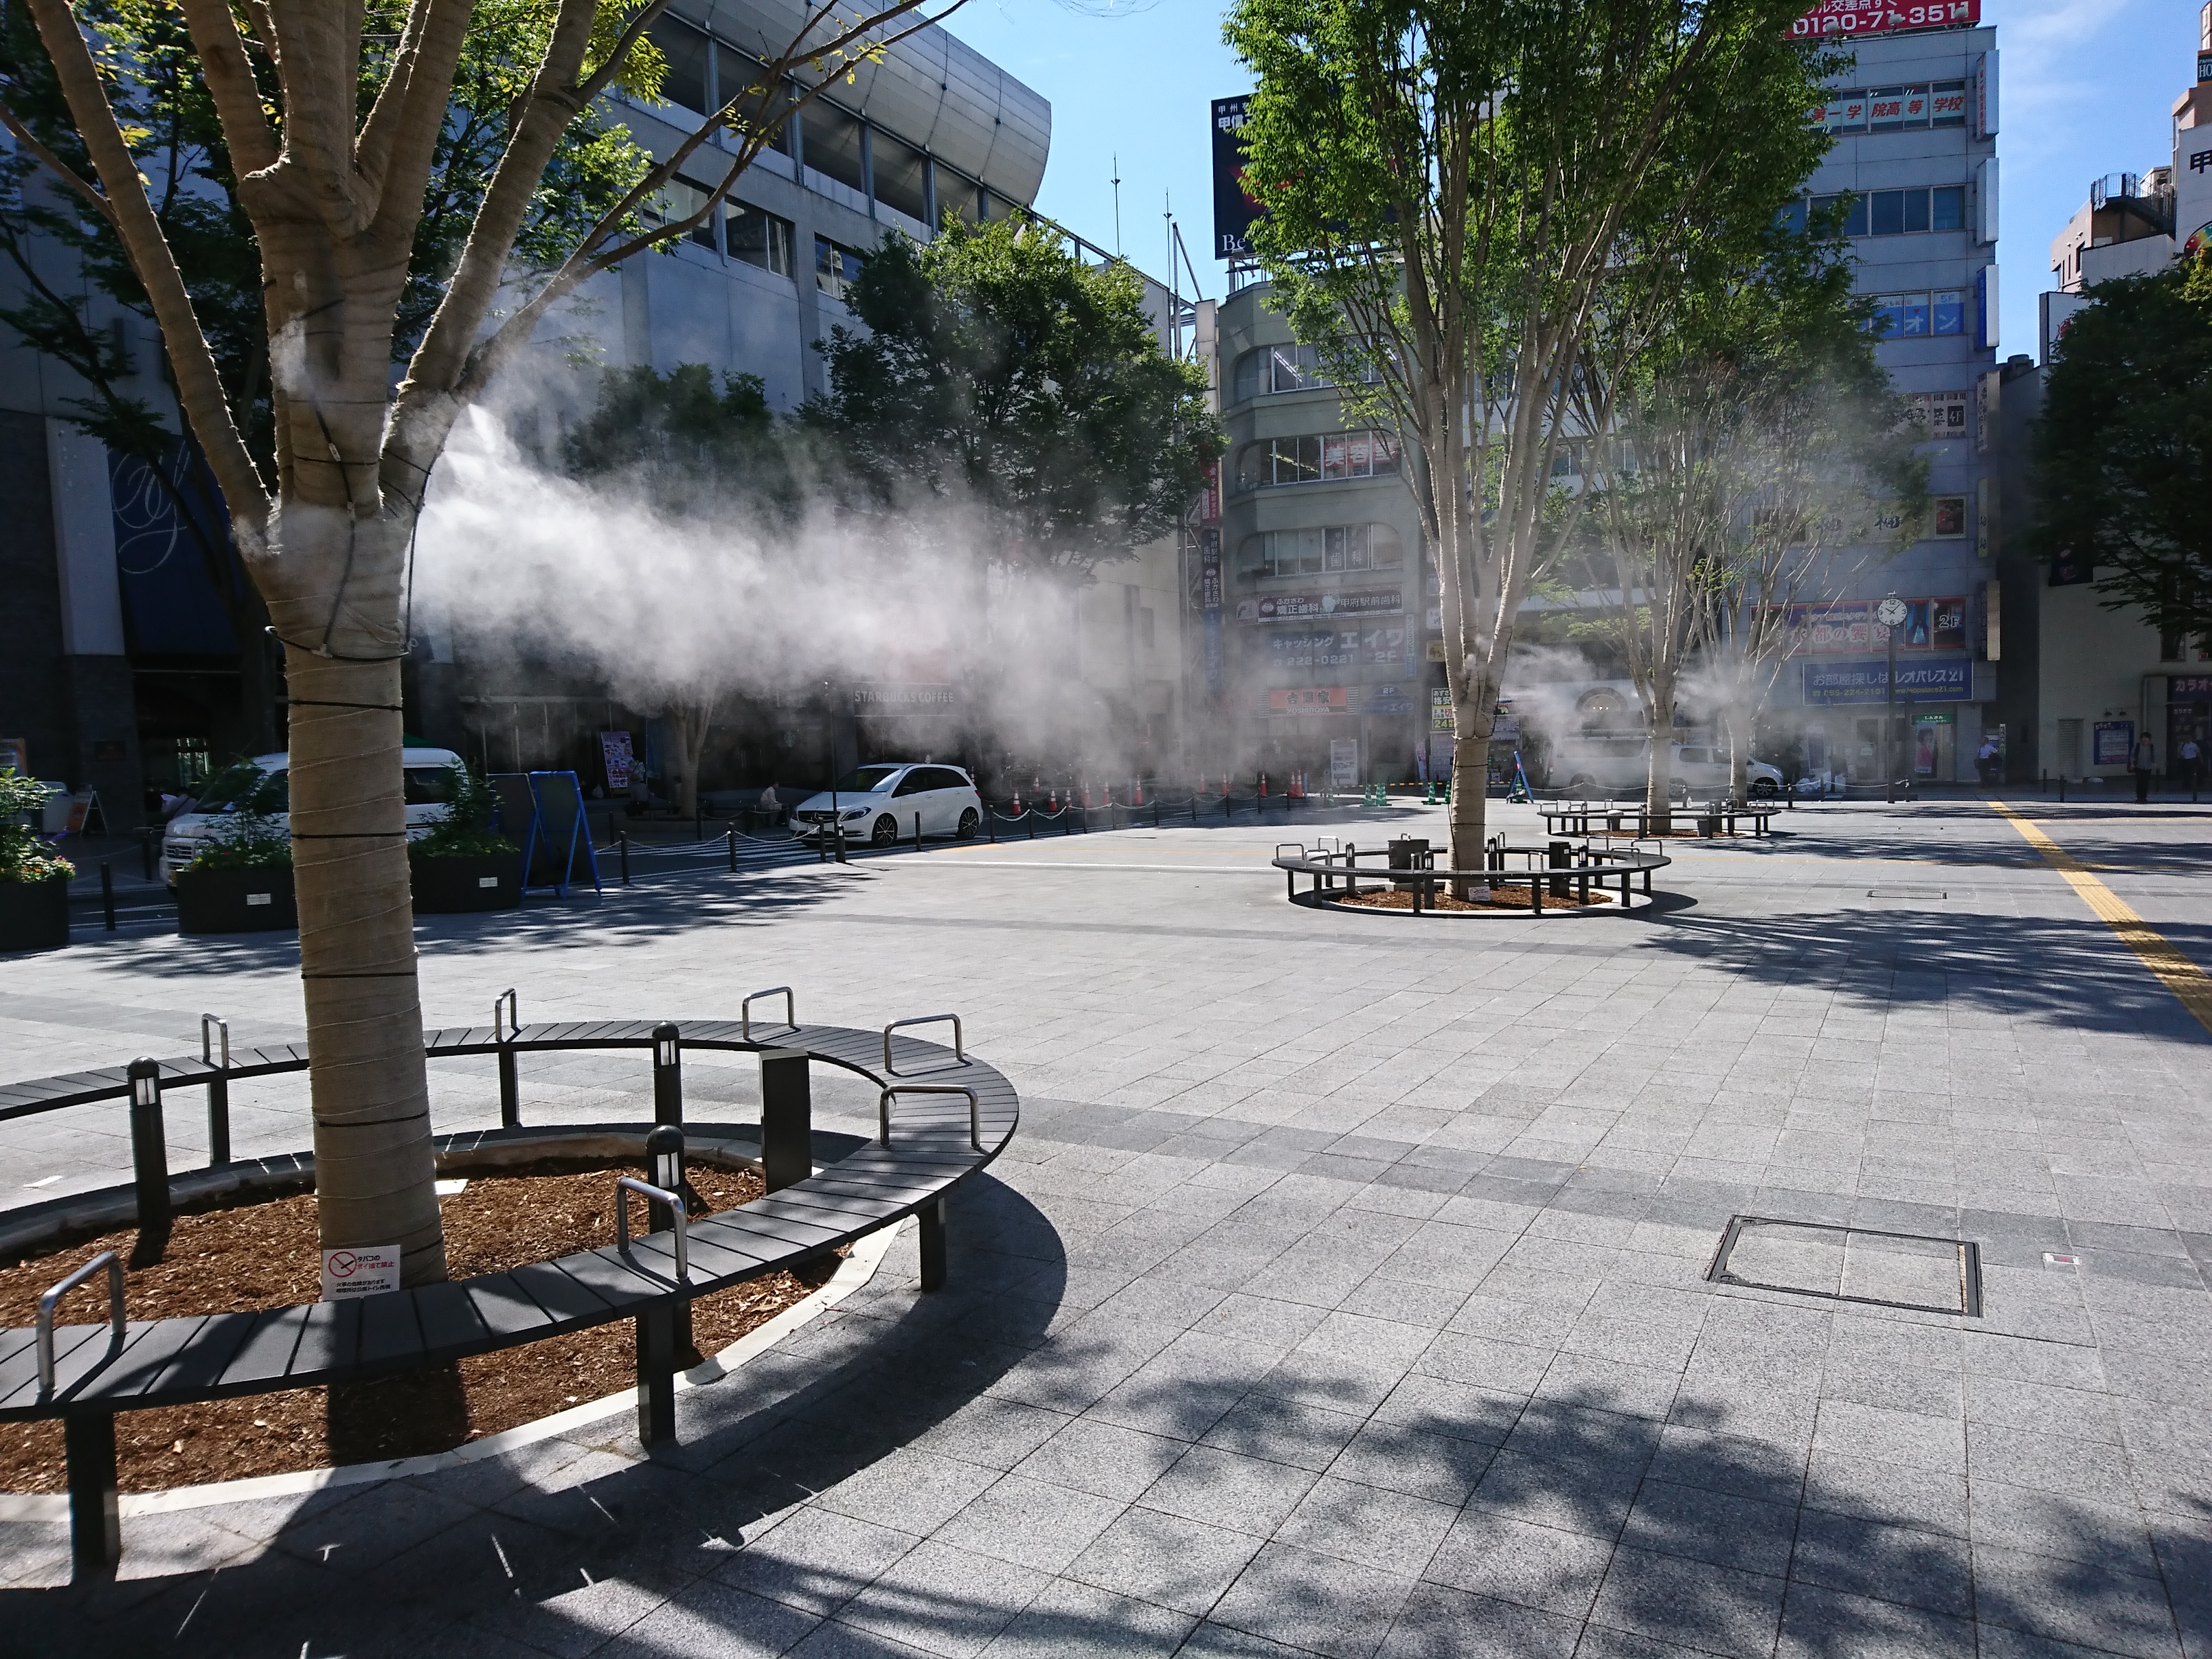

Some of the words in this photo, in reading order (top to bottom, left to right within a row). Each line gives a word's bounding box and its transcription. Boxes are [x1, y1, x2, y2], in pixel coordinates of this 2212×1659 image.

[1813, 96, 1965, 123] 第一学院高等学校
[1325, 442, 1397, 468] 美容室
[1340, 594, 1401, 608] 甲府駅前歯科
[1939, 614, 1961, 628] 2F
[1273, 636, 1334, 649] キャッシング
[1340, 629, 1404, 649] エイワ
[1288, 655, 1353, 666] 222-0221
[1375, 651, 1396, 663] 2F
[1813, 672, 1888, 687] お部屋探しは
[1895, 667, 1963, 684] レオパレス21
[2175, 679, 2212, 692] カラオ
[855, 691, 916, 703] STARBUCKS
[918, 692, 954, 703] COFFEE
[1287, 690, 1330, 705] 吉野家
[1434, 696, 1451, 705] 格安
